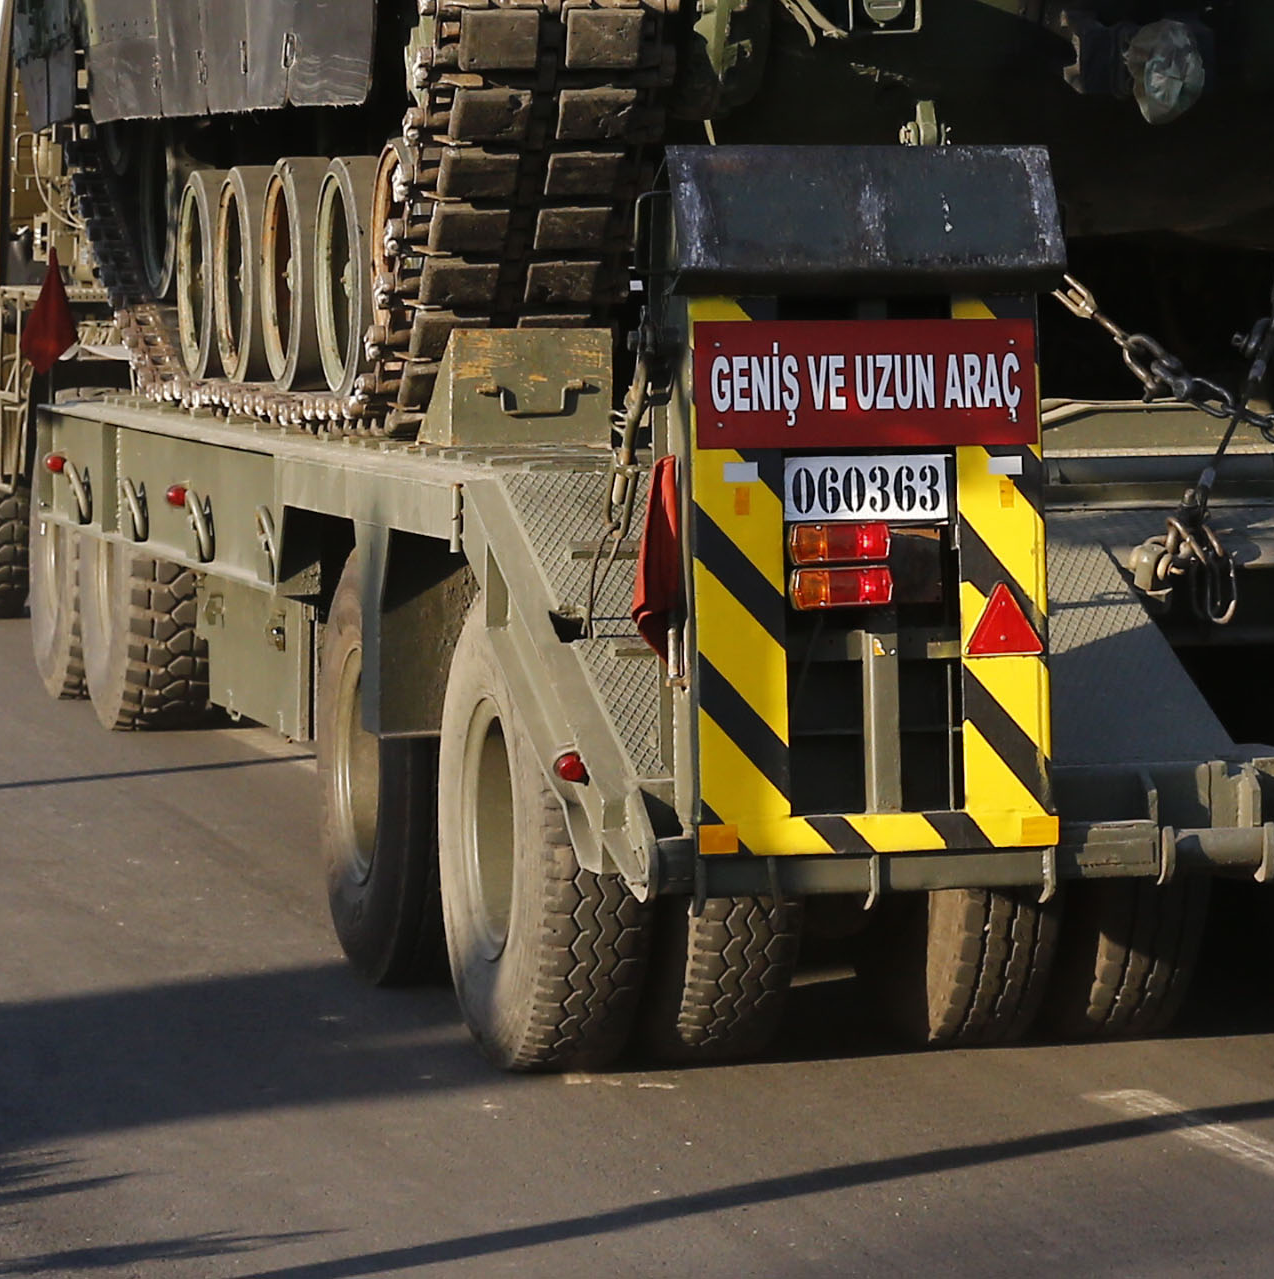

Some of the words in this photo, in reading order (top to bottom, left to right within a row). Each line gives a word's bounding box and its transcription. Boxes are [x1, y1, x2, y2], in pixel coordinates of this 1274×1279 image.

[711, 341, 801, 427] GENİŞ
[807, 355, 848, 411] VE
[854, 354, 936, 411] UZUN
[943, 352, 1021, 420] ARAÇ
[792, 464, 941, 515] 060363
